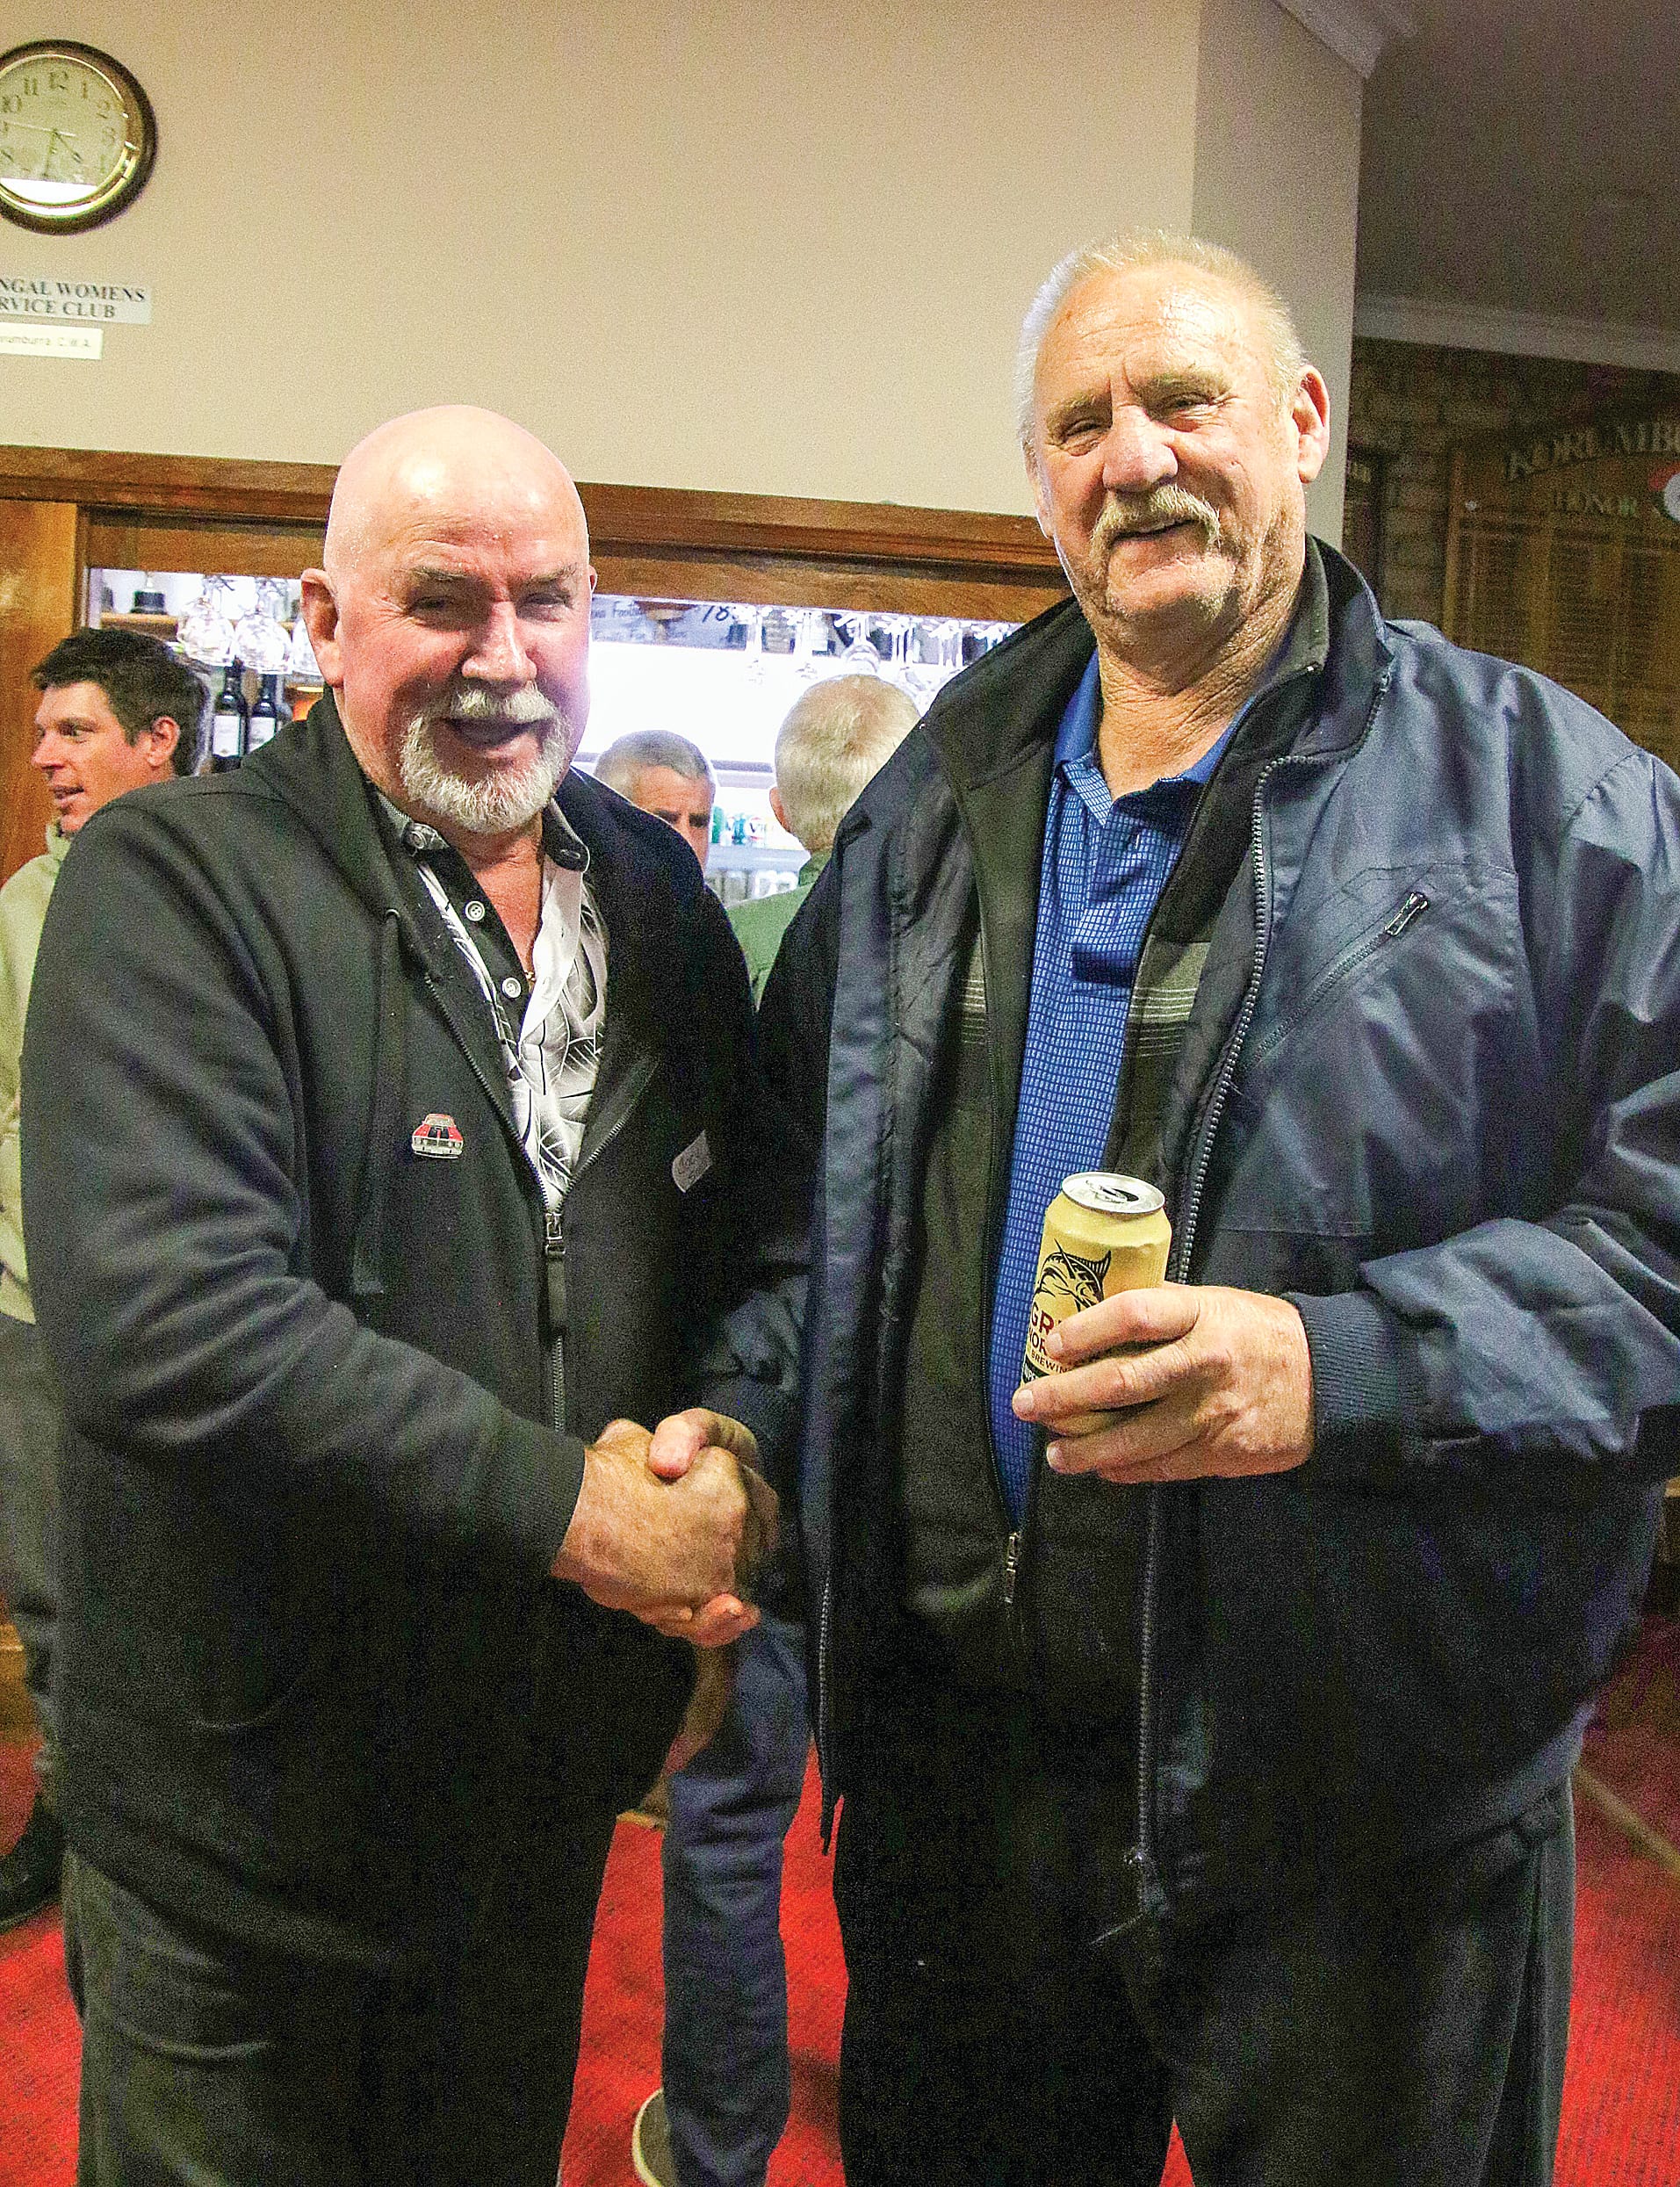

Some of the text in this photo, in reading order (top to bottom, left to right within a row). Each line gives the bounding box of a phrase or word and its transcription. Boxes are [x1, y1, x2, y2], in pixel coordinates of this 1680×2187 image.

[24, 77, 39, 96] 11
[49, 71, 69, 90] 12
[82, 82, 89, 98] 1
[2, 95, 23, 113] 10
[97, 100, 111, 119] 2
[56, 282, 146, 303] WOMENS
[63, 301, 116, 318] CLUB
